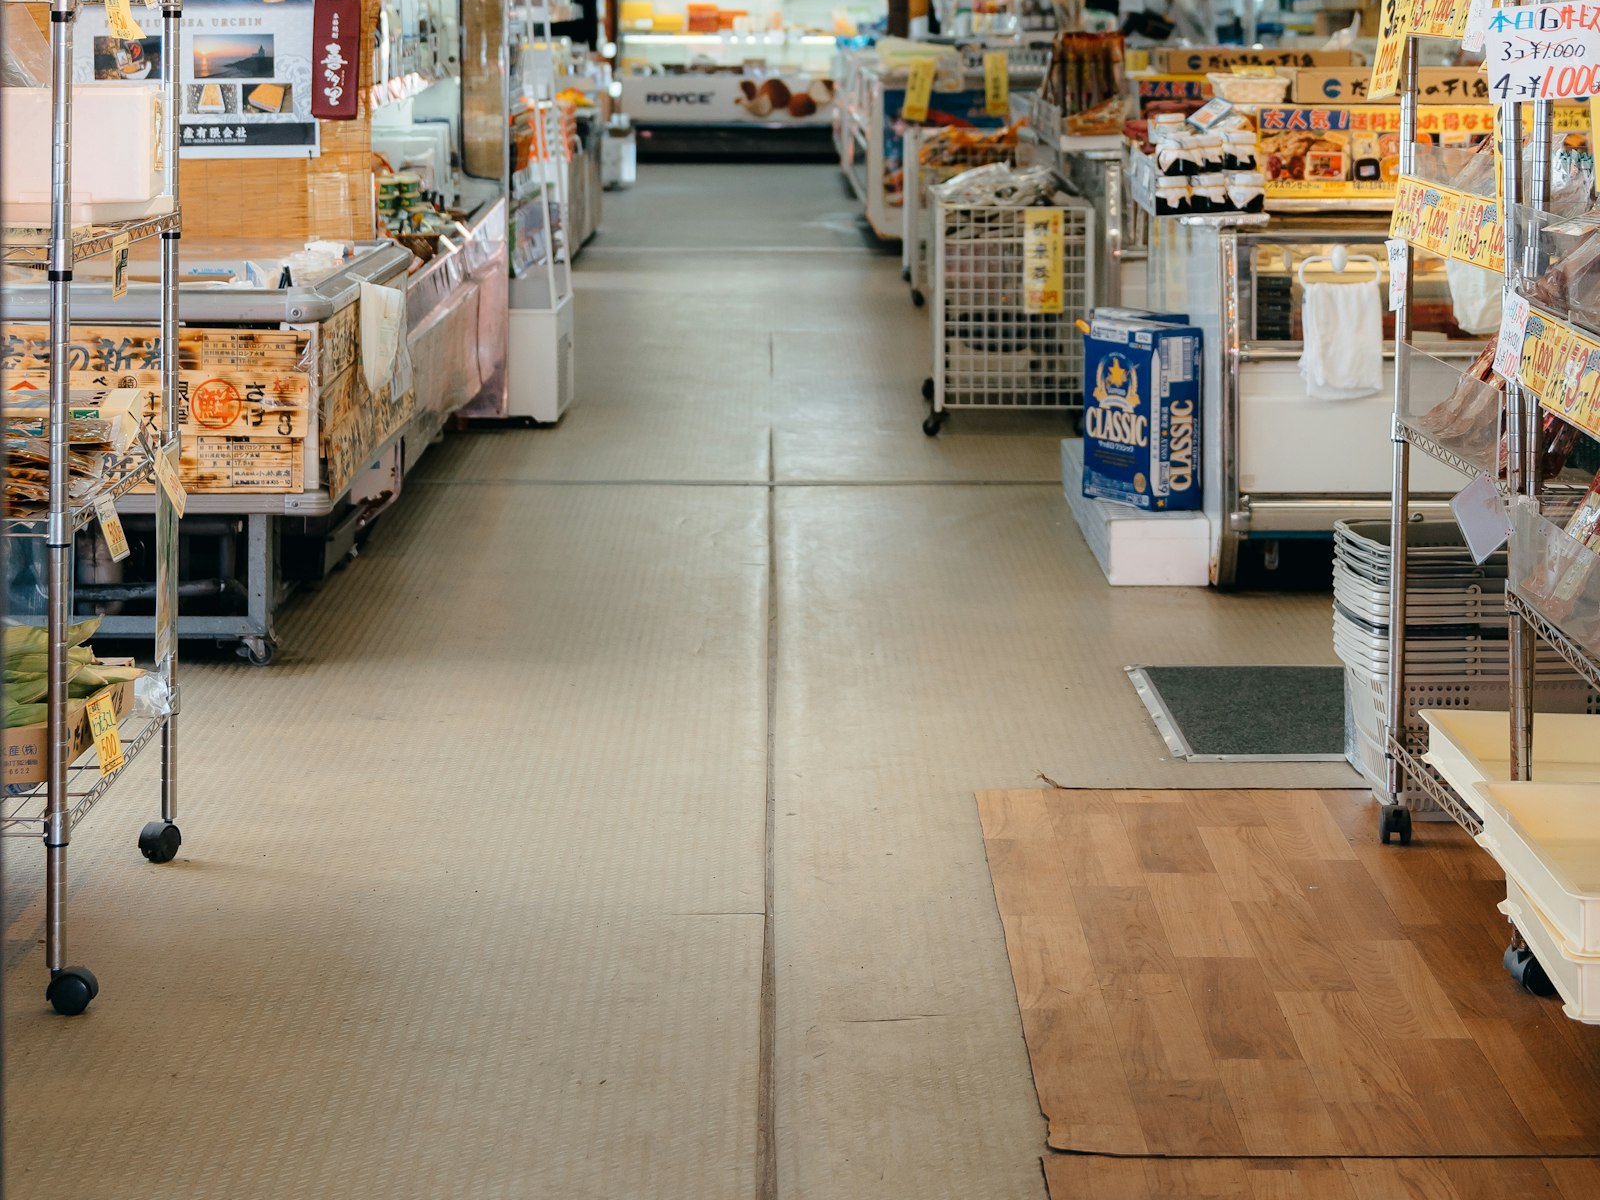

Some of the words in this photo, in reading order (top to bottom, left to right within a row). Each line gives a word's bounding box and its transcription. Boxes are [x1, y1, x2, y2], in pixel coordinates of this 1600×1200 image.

[181, 18, 204, 28] SEA
[212, 17, 263, 28] URCHIN
[1263, 108, 1350, 130] 大人気！
[1086, 405, 1148, 447] CLASSIC
[1169, 399, 1194, 492] CLASSIC
[100, 733, 117, 762] 500
